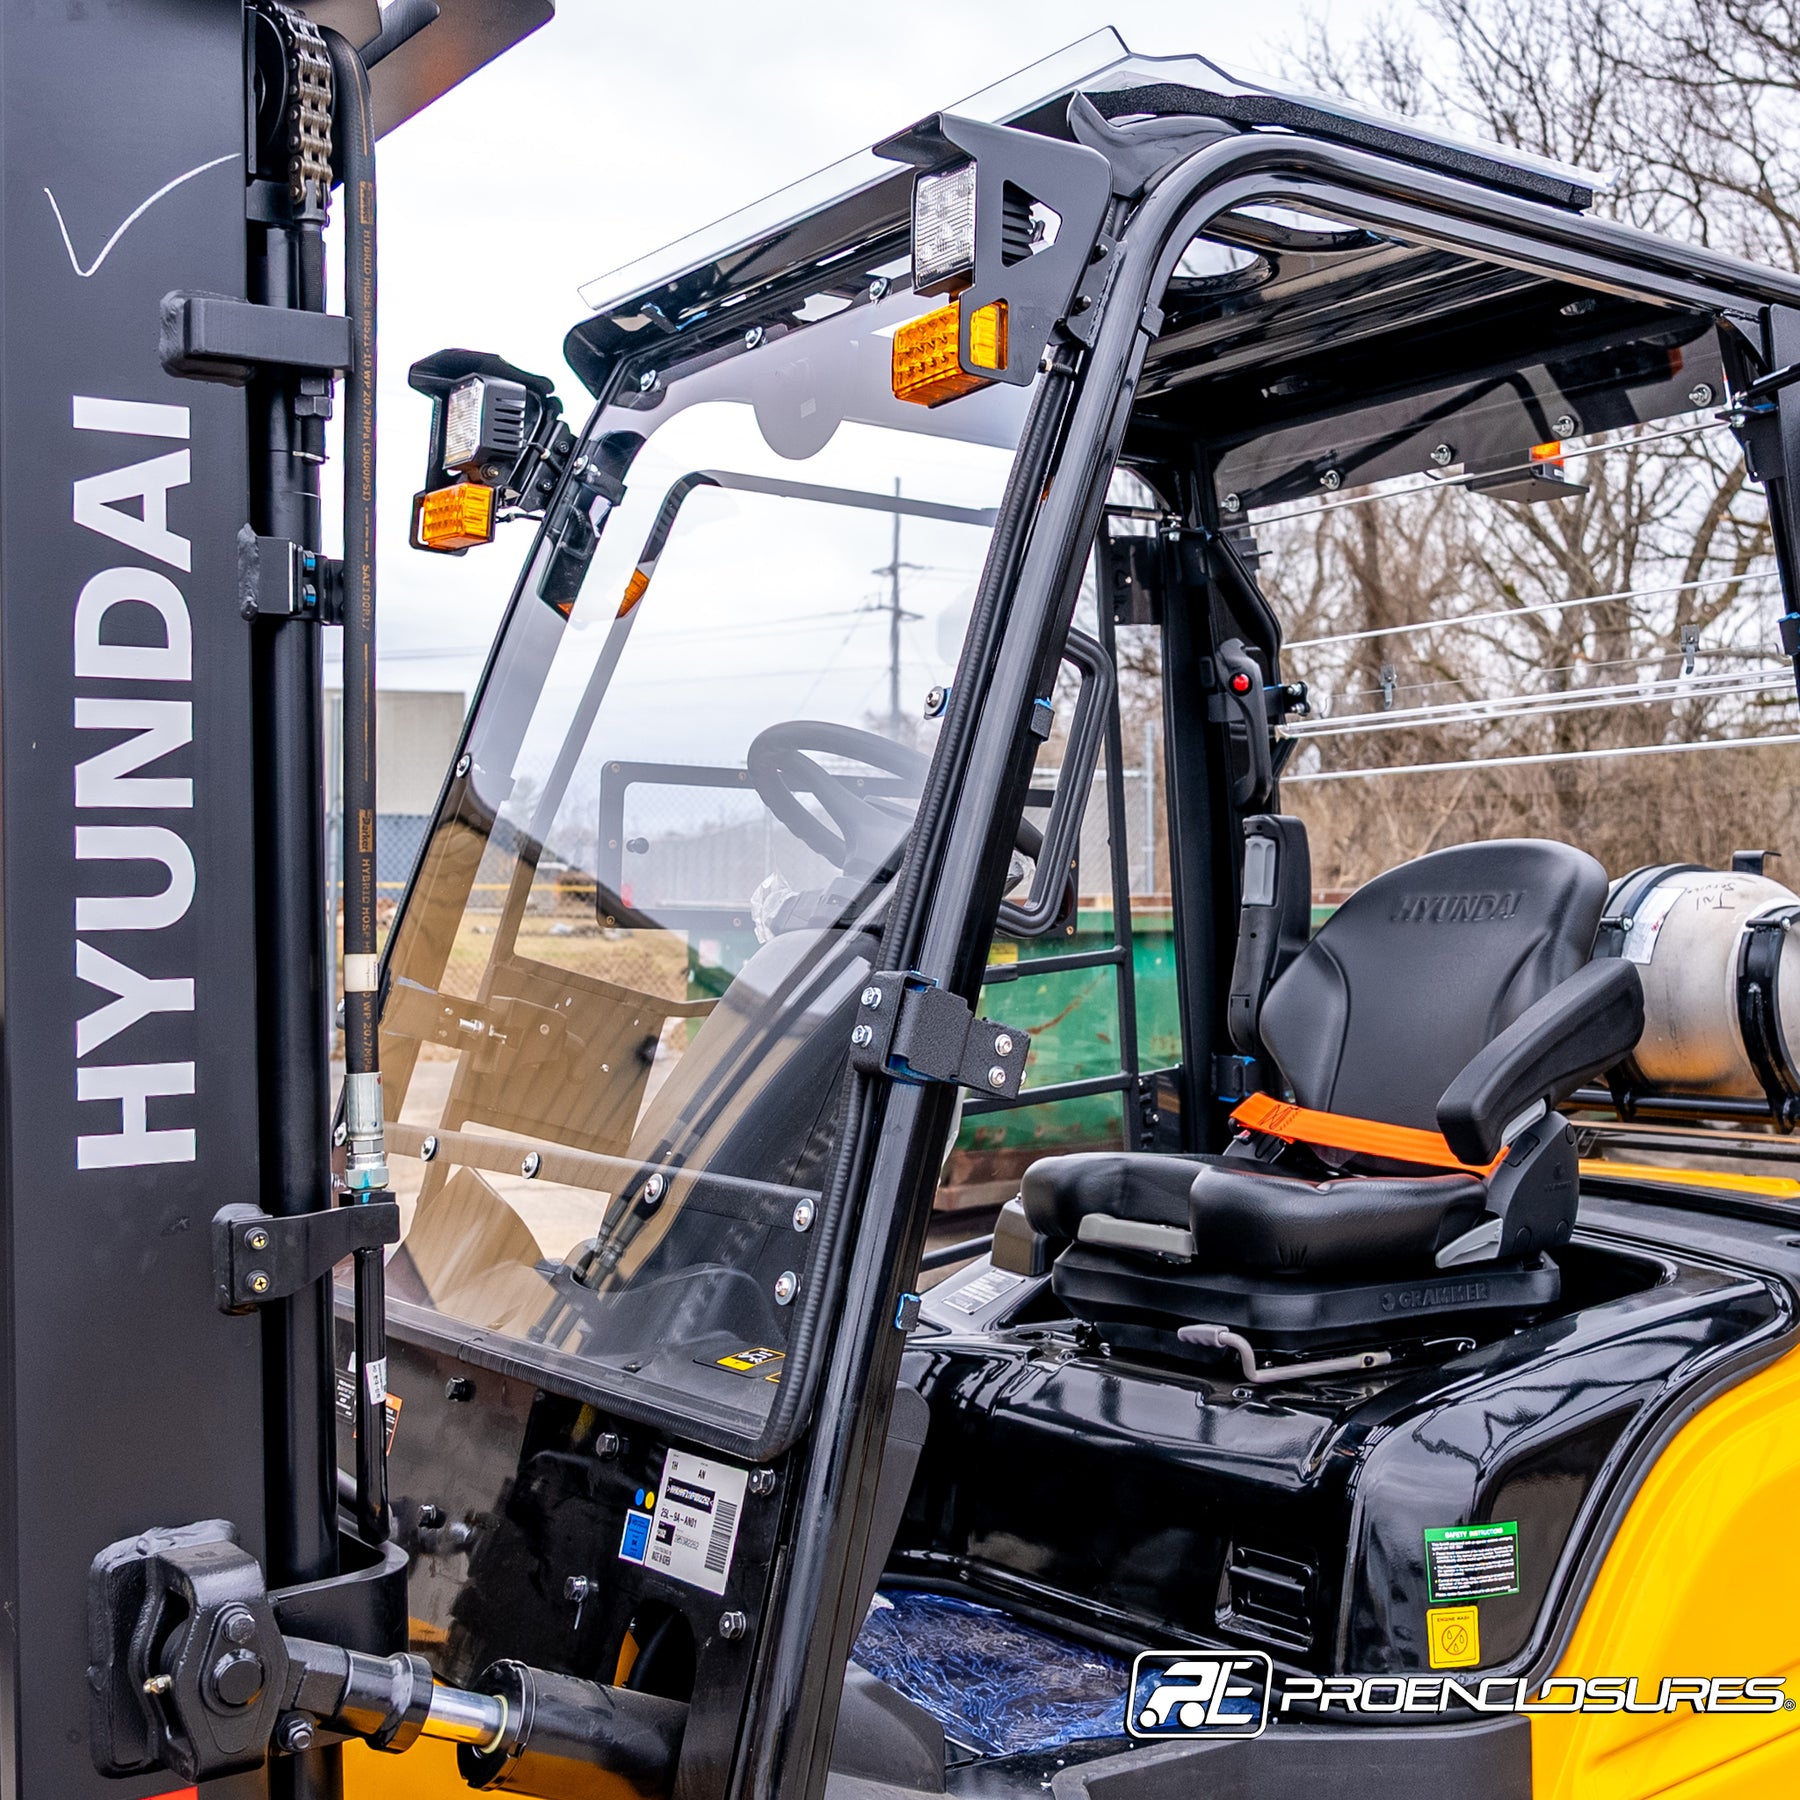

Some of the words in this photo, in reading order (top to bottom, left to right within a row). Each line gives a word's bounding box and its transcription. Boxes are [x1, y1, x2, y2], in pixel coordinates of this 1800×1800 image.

[363, 230, 372, 275] HYBRID
[363, 277, 372, 308] HOSE
[363, 370, 372, 389] WP
[363, 391, 372, 439] 20.7MPa
[362, 443, 372, 502] (3000PSI)
[73, 394, 197, 1169] HYUNDAI
[361, 858, 371, 904] HYBRID
[1390, 890, 1526, 922] HYUNDAI
[363, 1001, 372, 1020] WP
[1399, 1283, 1489, 1308] GRAMMER
